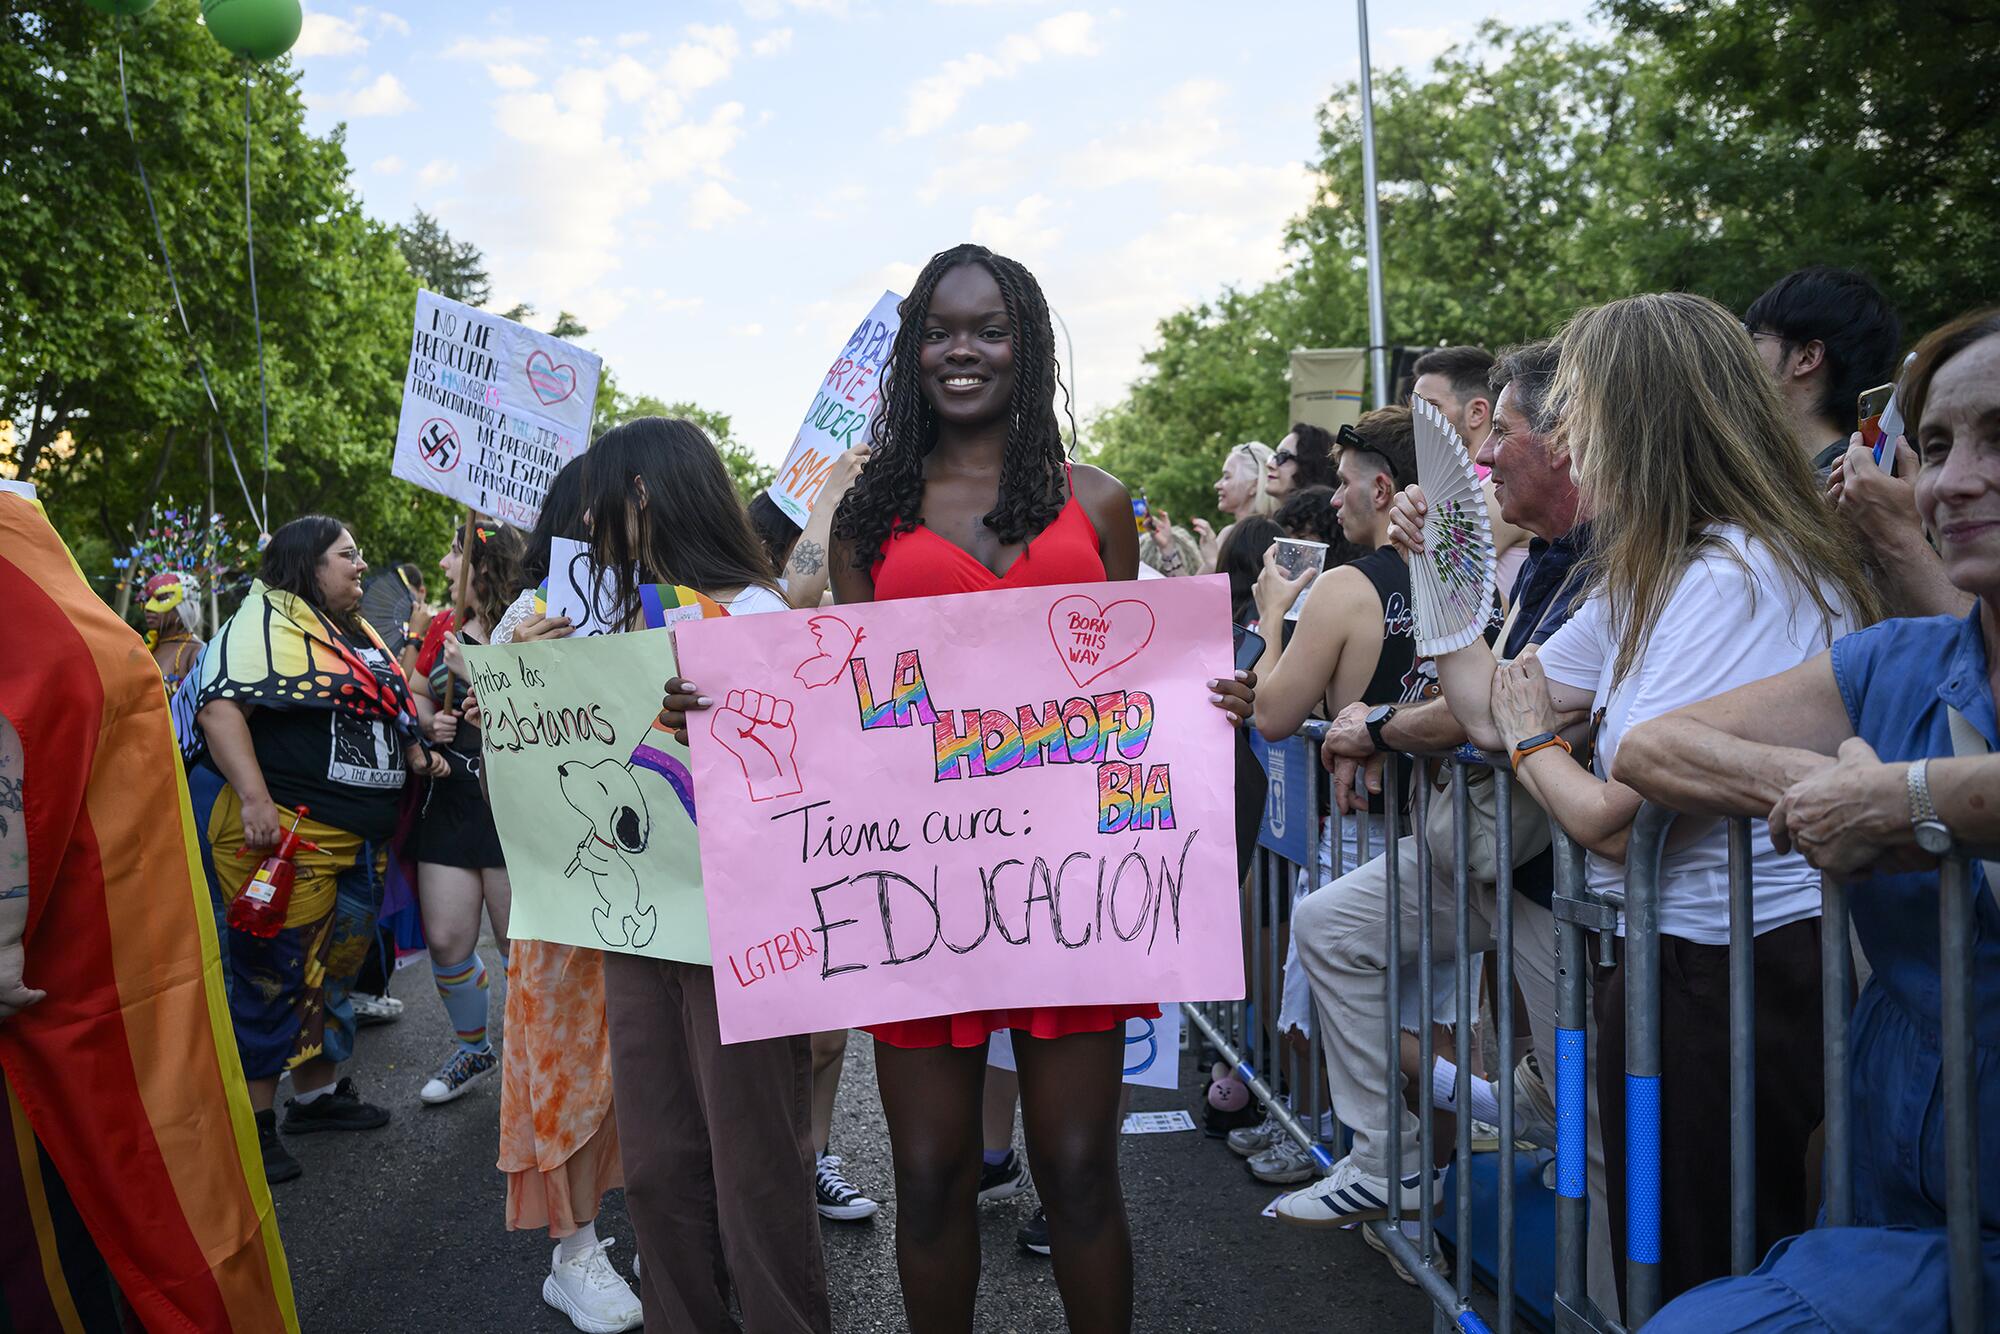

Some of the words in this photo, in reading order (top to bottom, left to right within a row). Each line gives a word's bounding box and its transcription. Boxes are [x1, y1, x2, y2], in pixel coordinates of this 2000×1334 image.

[432, 308, 457, 337] NO
[463, 320, 495, 351] ME
[413, 358, 436, 381] LOS
[416, 330, 499, 382] PREOCUPAN
[497, 413, 507, 431] A
[478, 425, 497, 448] ME
[500, 434, 562, 472] PREOCUPAN
[480, 448, 505, 473] LOS
[481, 491, 488, 508] A
[1067, 611, 1112, 634] BORN
[1071, 632, 1106, 650] THIS
[1068, 647, 1100, 666] WAY
[469, 660, 511, 706] Arriba
[518, 655, 545, 688] las
[850, 649, 938, 730] LA
[483, 697, 615, 753] esbianas
[932, 690, 1155, 783] HOMOFO
[351, 767, 367, 781] THE
[1097, 761, 1177, 834] BIA
[771, 800, 911, 863] Tiene
[922, 807, 1034, 846] cura:
[811, 828, 1199, 981] EDUCACIÓN
[729, 926, 818, 987] LGTBIQ
